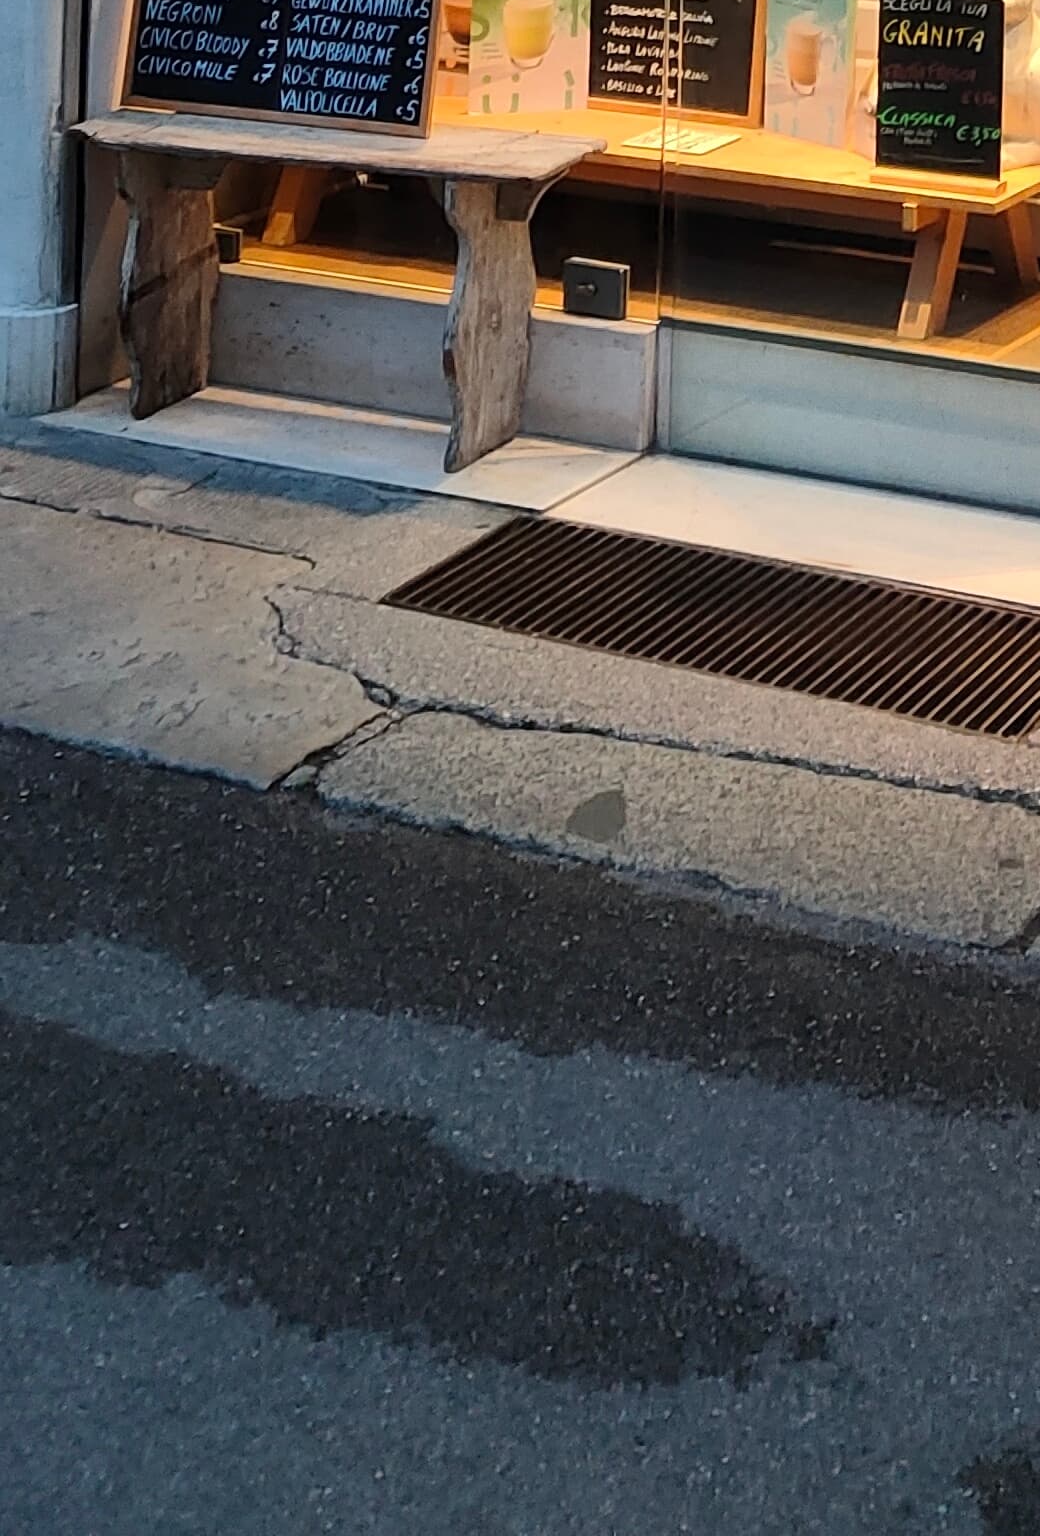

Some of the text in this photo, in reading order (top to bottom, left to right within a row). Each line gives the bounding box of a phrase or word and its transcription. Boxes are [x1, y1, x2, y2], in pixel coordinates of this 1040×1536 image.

[139, 26, 194, 50] CIVICO
[195, 30, 250, 60] BLOODY
[882, 18, 986, 53] GRANITA
[878, 105, 957, 128] CLASSICA
